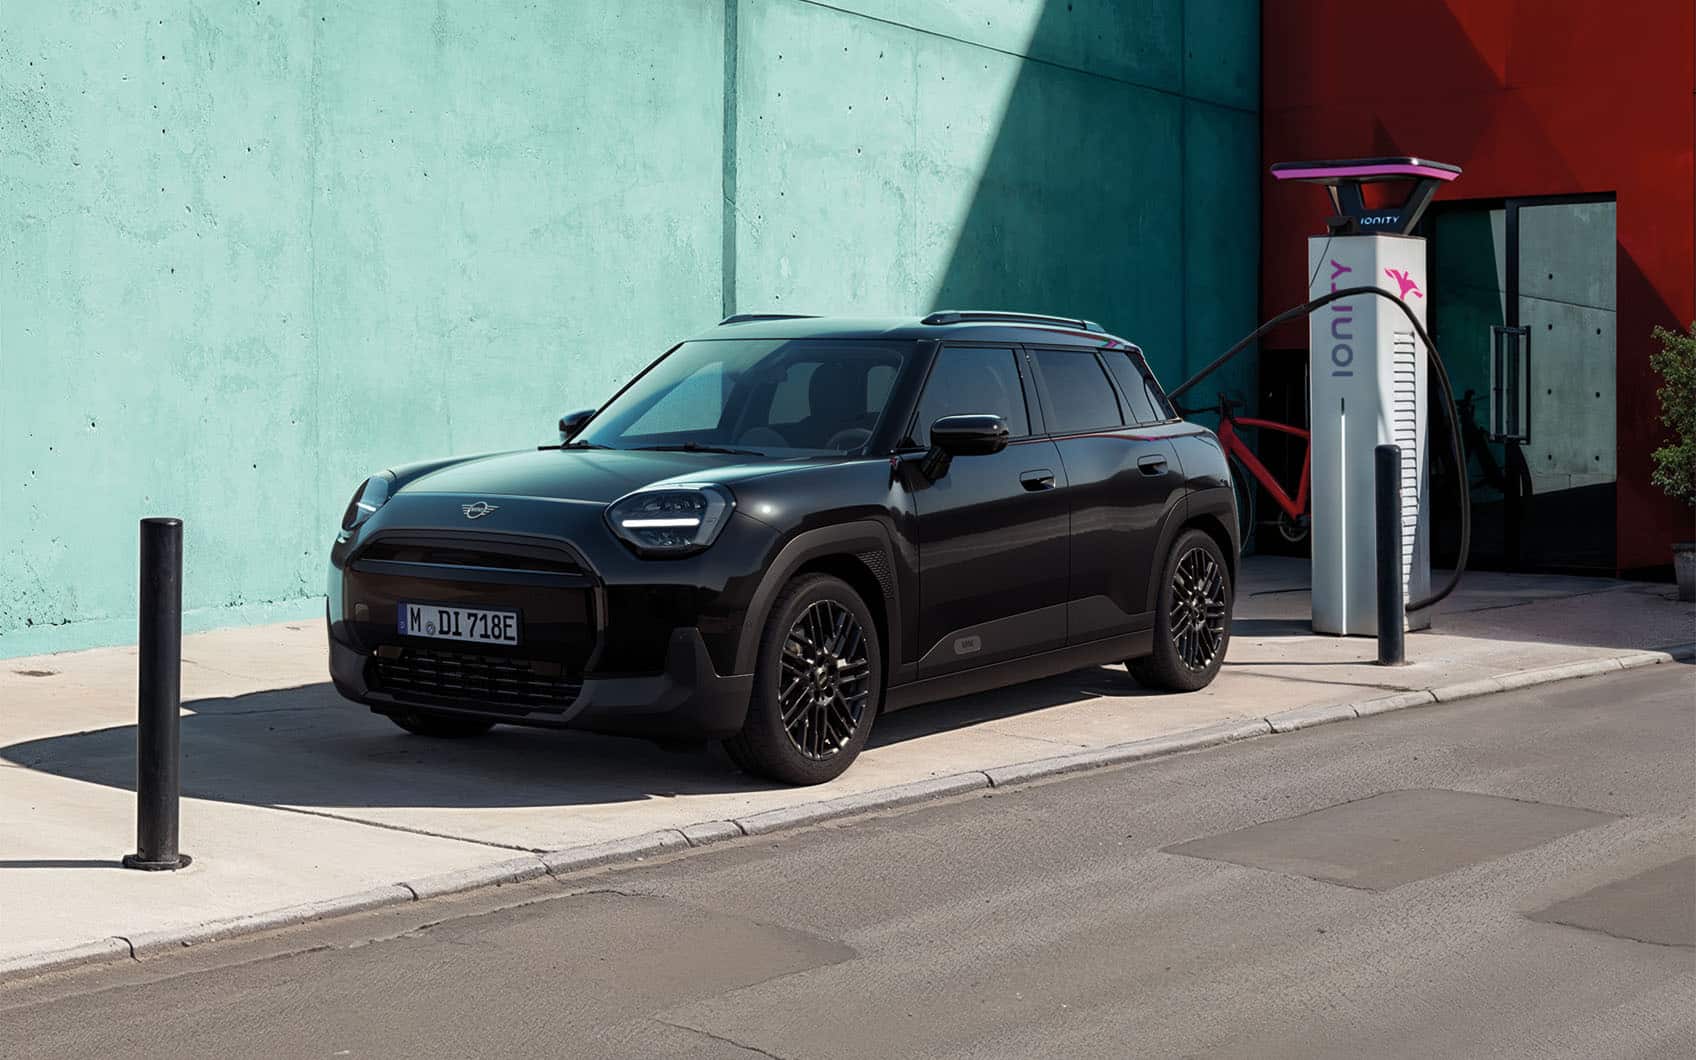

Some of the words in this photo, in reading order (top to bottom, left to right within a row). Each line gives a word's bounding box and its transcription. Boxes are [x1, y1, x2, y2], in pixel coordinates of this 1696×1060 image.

[1360, 216, 1400, 225] IONITY
[410, 607, 421, 632] M
[467, 612, 516, 641] 718E
